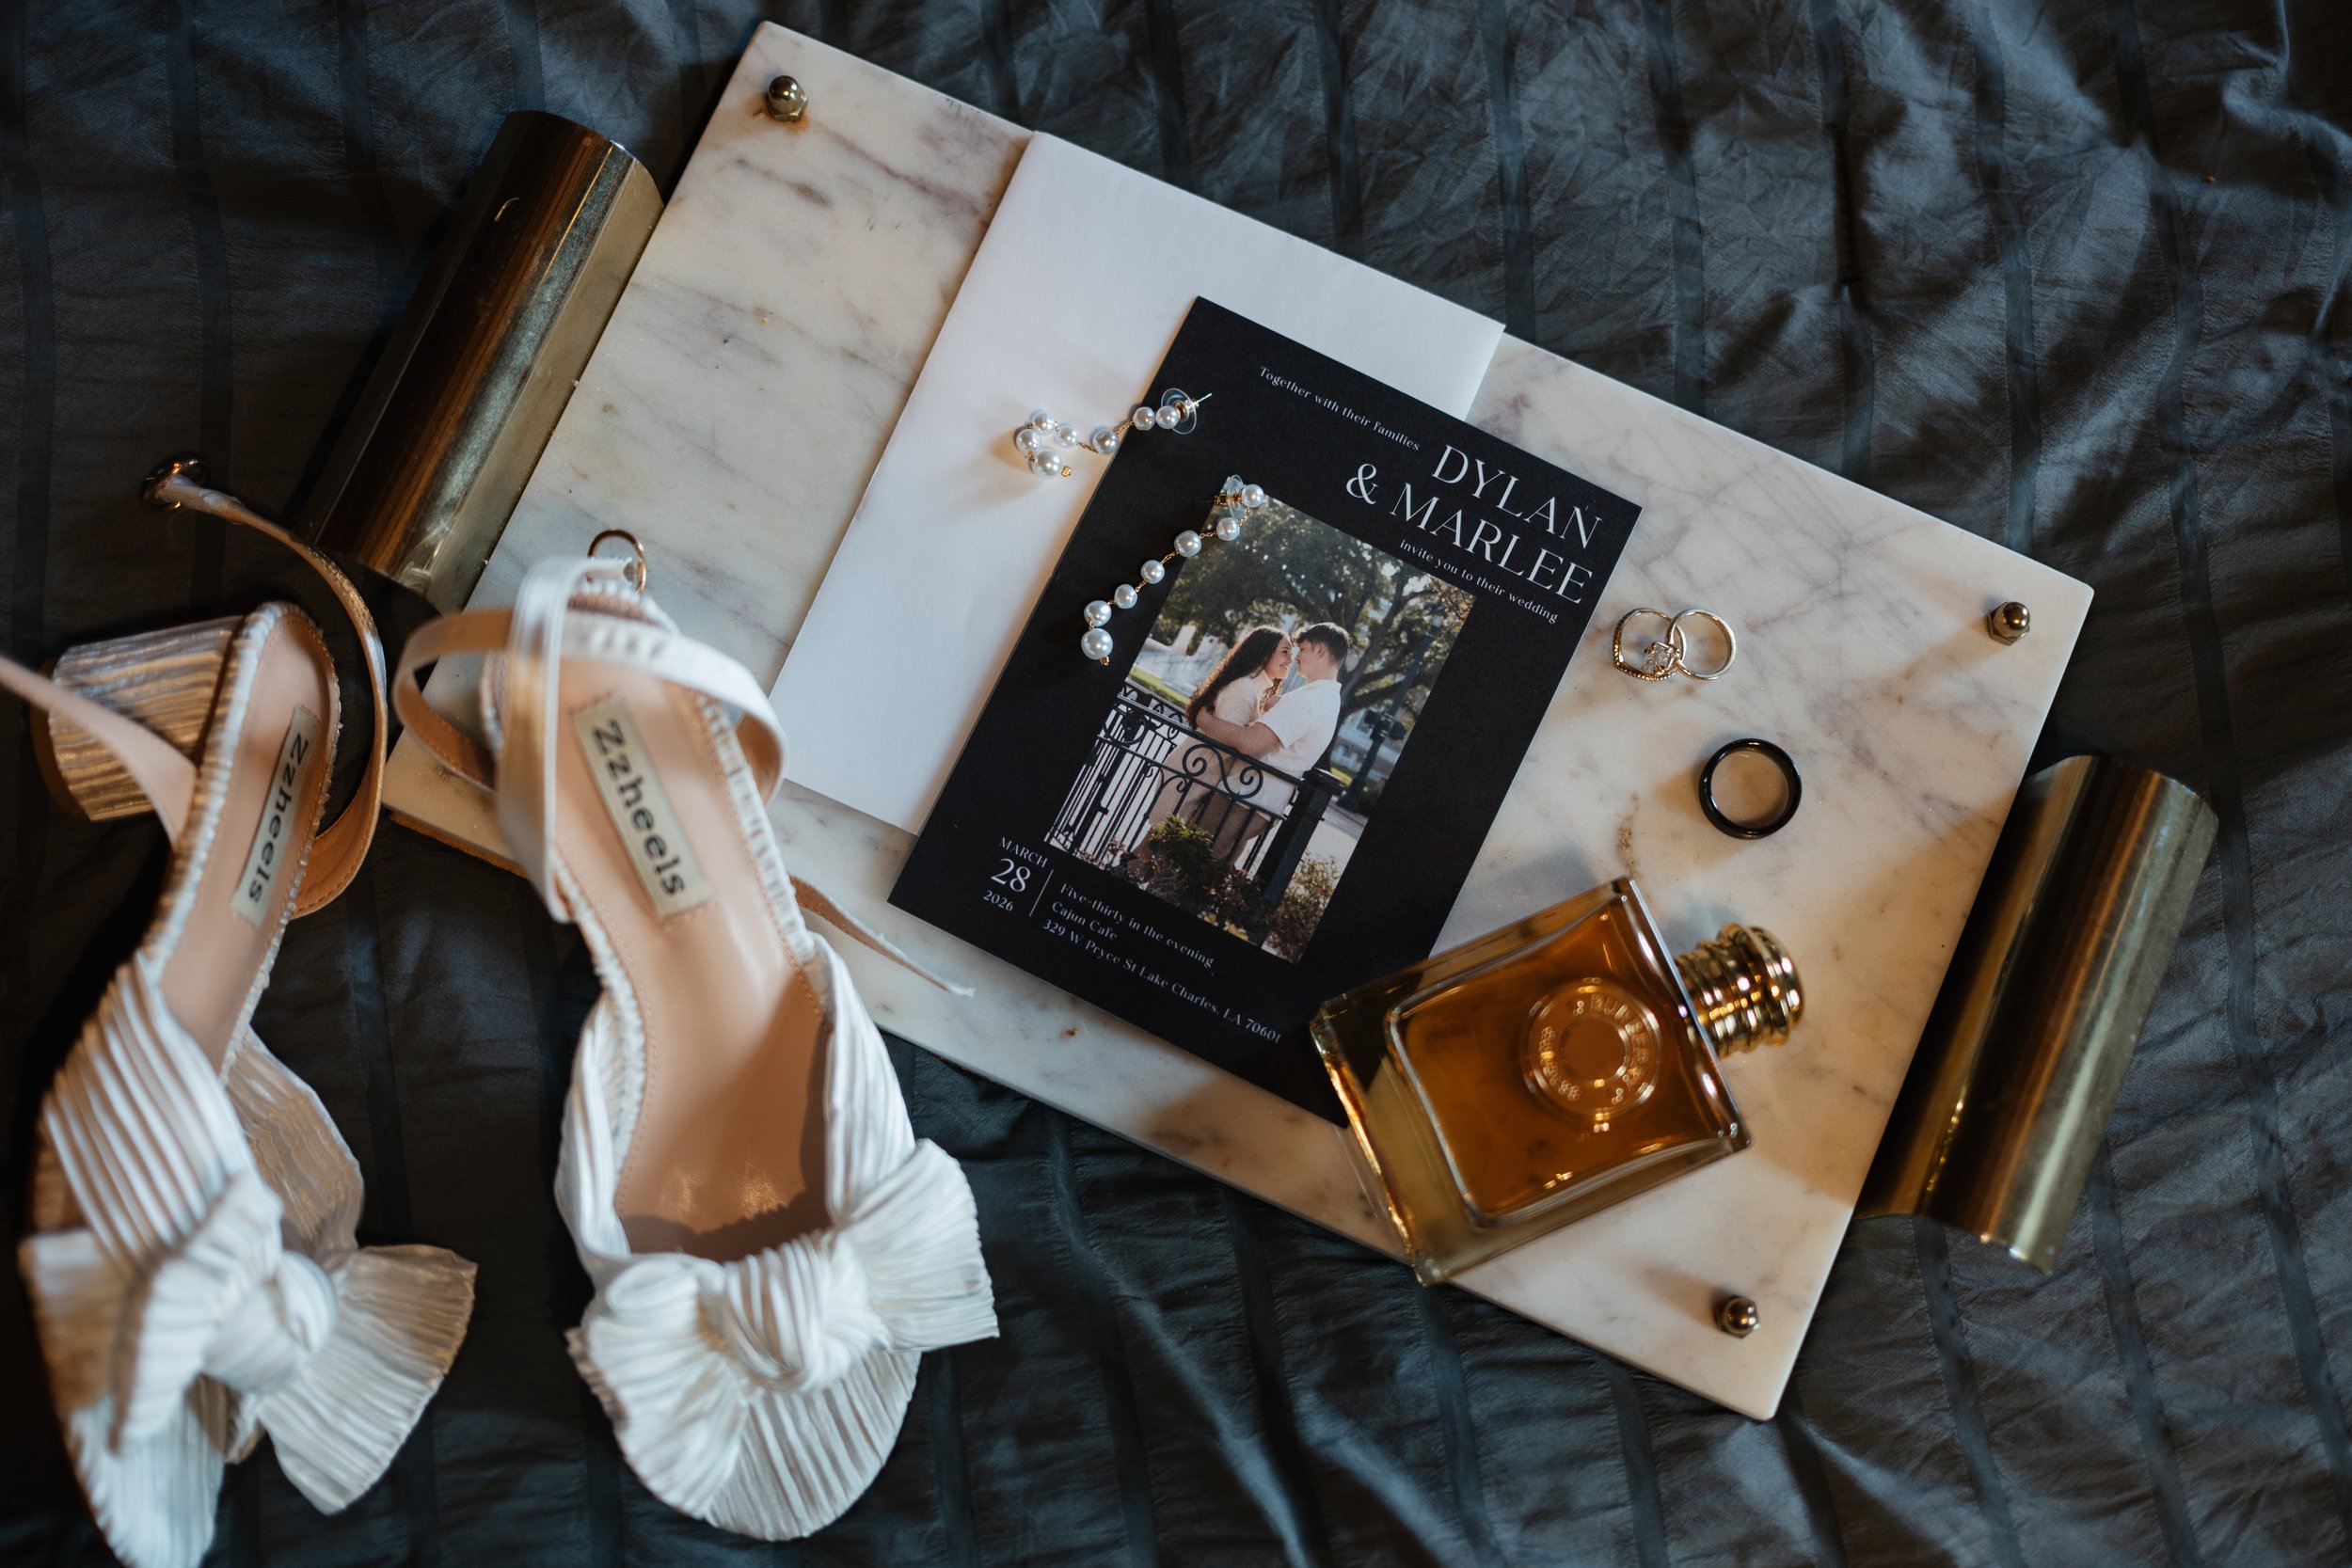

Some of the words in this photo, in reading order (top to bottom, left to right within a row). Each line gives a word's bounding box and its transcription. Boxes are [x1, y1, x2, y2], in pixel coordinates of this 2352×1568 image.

[1260, 366, 1311, 399] Together
[1315, 393, 1339, 412] with
[1342, 405, 1372, 426] their
[1373, 421, 1420, 451] families
[1345, 463, 1379, 505] &
[1390, 482, 1594, 604] MARLEE
[1431, 444, 1602, 549] DYLAN
[1400, 539, 1434, 563] invite
[1437, 558, 1458, 575] you
[1461, 568, 1474, 581] to
[1476, 575, 1505, 597] their
[1508, 593, 1559, 625] wedding
[247, 730, 310, 905] Zzheels
[590, 717, 687, 897] Zzheels
[991, 858, 1031, 893] 28
[998, 836, 1048, 868] MARCH
[983, 890, 1014, 911] 2026
[1052, 901, 1087, 927] Cajun
[1089, 920, 1118, 941] Cafe
[1060, 883, 1126, 925] Five-thirty
[1129, 918, 1140, 930] in
[1143, 927, 1164, 942] the
[1167, 937, 1216, 969] evening
[1042, 919, 1066, 936] 329
[1070, 930, 1083, 943] W
[1085, 940, 1120, 964] Pryce
[1123, 958, 1136, 973] St
[1139, 966, 1168, 988] Lake
[1223, 1007, 1242, 1025] LA
[1246, 1019, 1281, 1043] 70601
